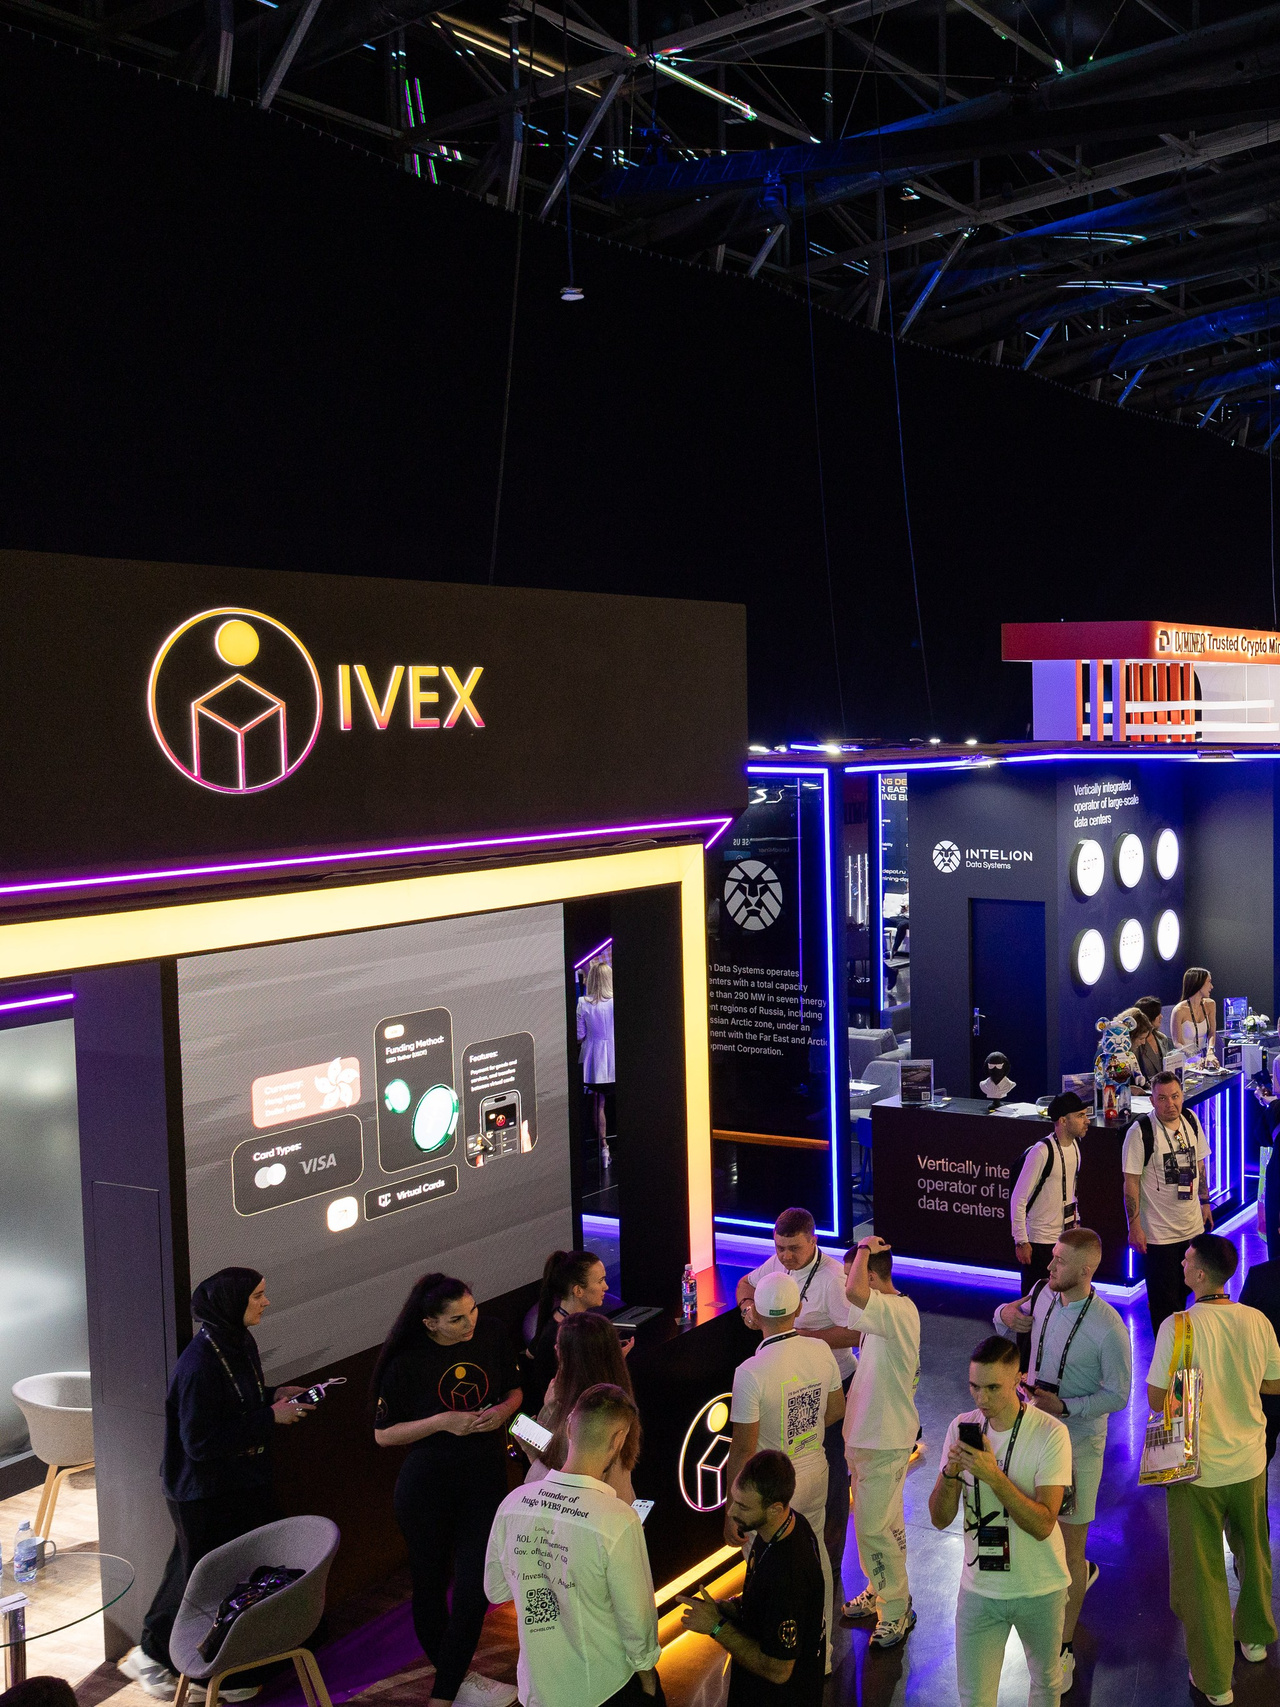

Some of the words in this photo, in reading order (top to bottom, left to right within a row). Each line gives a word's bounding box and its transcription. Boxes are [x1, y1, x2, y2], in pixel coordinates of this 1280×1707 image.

[1175, 631, 1206, 653] DJMINER
[1207, 633, 1239, 651] Trusted
[1241, 636, 1267, 656] Crypto
[338, 664, 486, 731] IVEX
[1074, 782, 1101, 797] Vertically
[1102, 779, 1131, 794] integrated
[1074, 797, 1100, 814] operator
[1101, 797, 1107, 809] of
[1108, 794, 1139, 810] large-scale
[1074, 816, 1088, 829] data
[1089, 813, 1111, 827] centers
[966, 849, 1033, 861] INTELION
[983, 861, 1011, 870] Systems
[714, 964, 731, 973] Data
[733, 965, 764, 975] Systems
[766, 968, 800, 977] operates
[733, 978, 749, 987] with
[757, 981, 774, 989] total
[775, 983, 808, 993] capacity
[716, 991, 732, 999] than
[734, 992, 748, 1000] 290
[750, 993, 766, 1001] MW
[767, 994, 774, 1002] in
[776, 996, 798, 1004] seven
[800, 998, 827, 1008] energy
[720, 1005, 748, 1014] regions
[749, 1006, 757, 1014] of
[759, 1007, 786, 1018] Russia,
[787, 1009, 823, 1022] including
[731, 1018, 752, 1027] Arctic
[754, 1021, 775, 1030] zone,
[777, 1022, 799, 1031] under
[385, 1043, 415, 1056] Funding
[415, 1035, 445, 1049] Method:
[728, 1031, 744, 1040] with
[745, 1032, 757, 1041] the
[759, 1033, 771, 1041] Far
[773, 1034, 789, 1043] East
[791, 1036, 805, 1045] and
[469, 1051, 499, 1063] Features:
[737, 1045, 784, 1056] Corporation.
[470, 1066, 489, 1075] Payment
[496, 1062, 508, 1070] goods
[498, 1068, 516, 1077] transfers
[264, 1080, 304, 1095] Currency:
[470, 1083, 489, 1092] between
[489, 1078, 503, 1087] virtual
[504, 1076, 515, 1084] cards
[253, 1147, 275, 1161] Card
[276, 1142, 302, 1158] Types:
[299, 1153, 337, 1175] VISA
[917, 1154, 981, 1179] Vertically
[397, 1185, 422, 1200] Virtual
[422, 1179, 445, 1192] Cards
[917, 1178, 977, 1195] operator
[981, 1183, 995, 1198] of
[918, 1195, 949, 1212] data
[952, 1201, 1005, 1219] centers
[538, 1488, 568, 1501] Founder
[568, 1495, 580, 1503] of
[521, 1495, 539, 1507] huge
[541, 1500, 561, 1511] WEB3
[560, 1506, 590, 1519] project
[516, 1534, 531, 1543] KOL
[513, 1547, 529, 1556] Gov.
